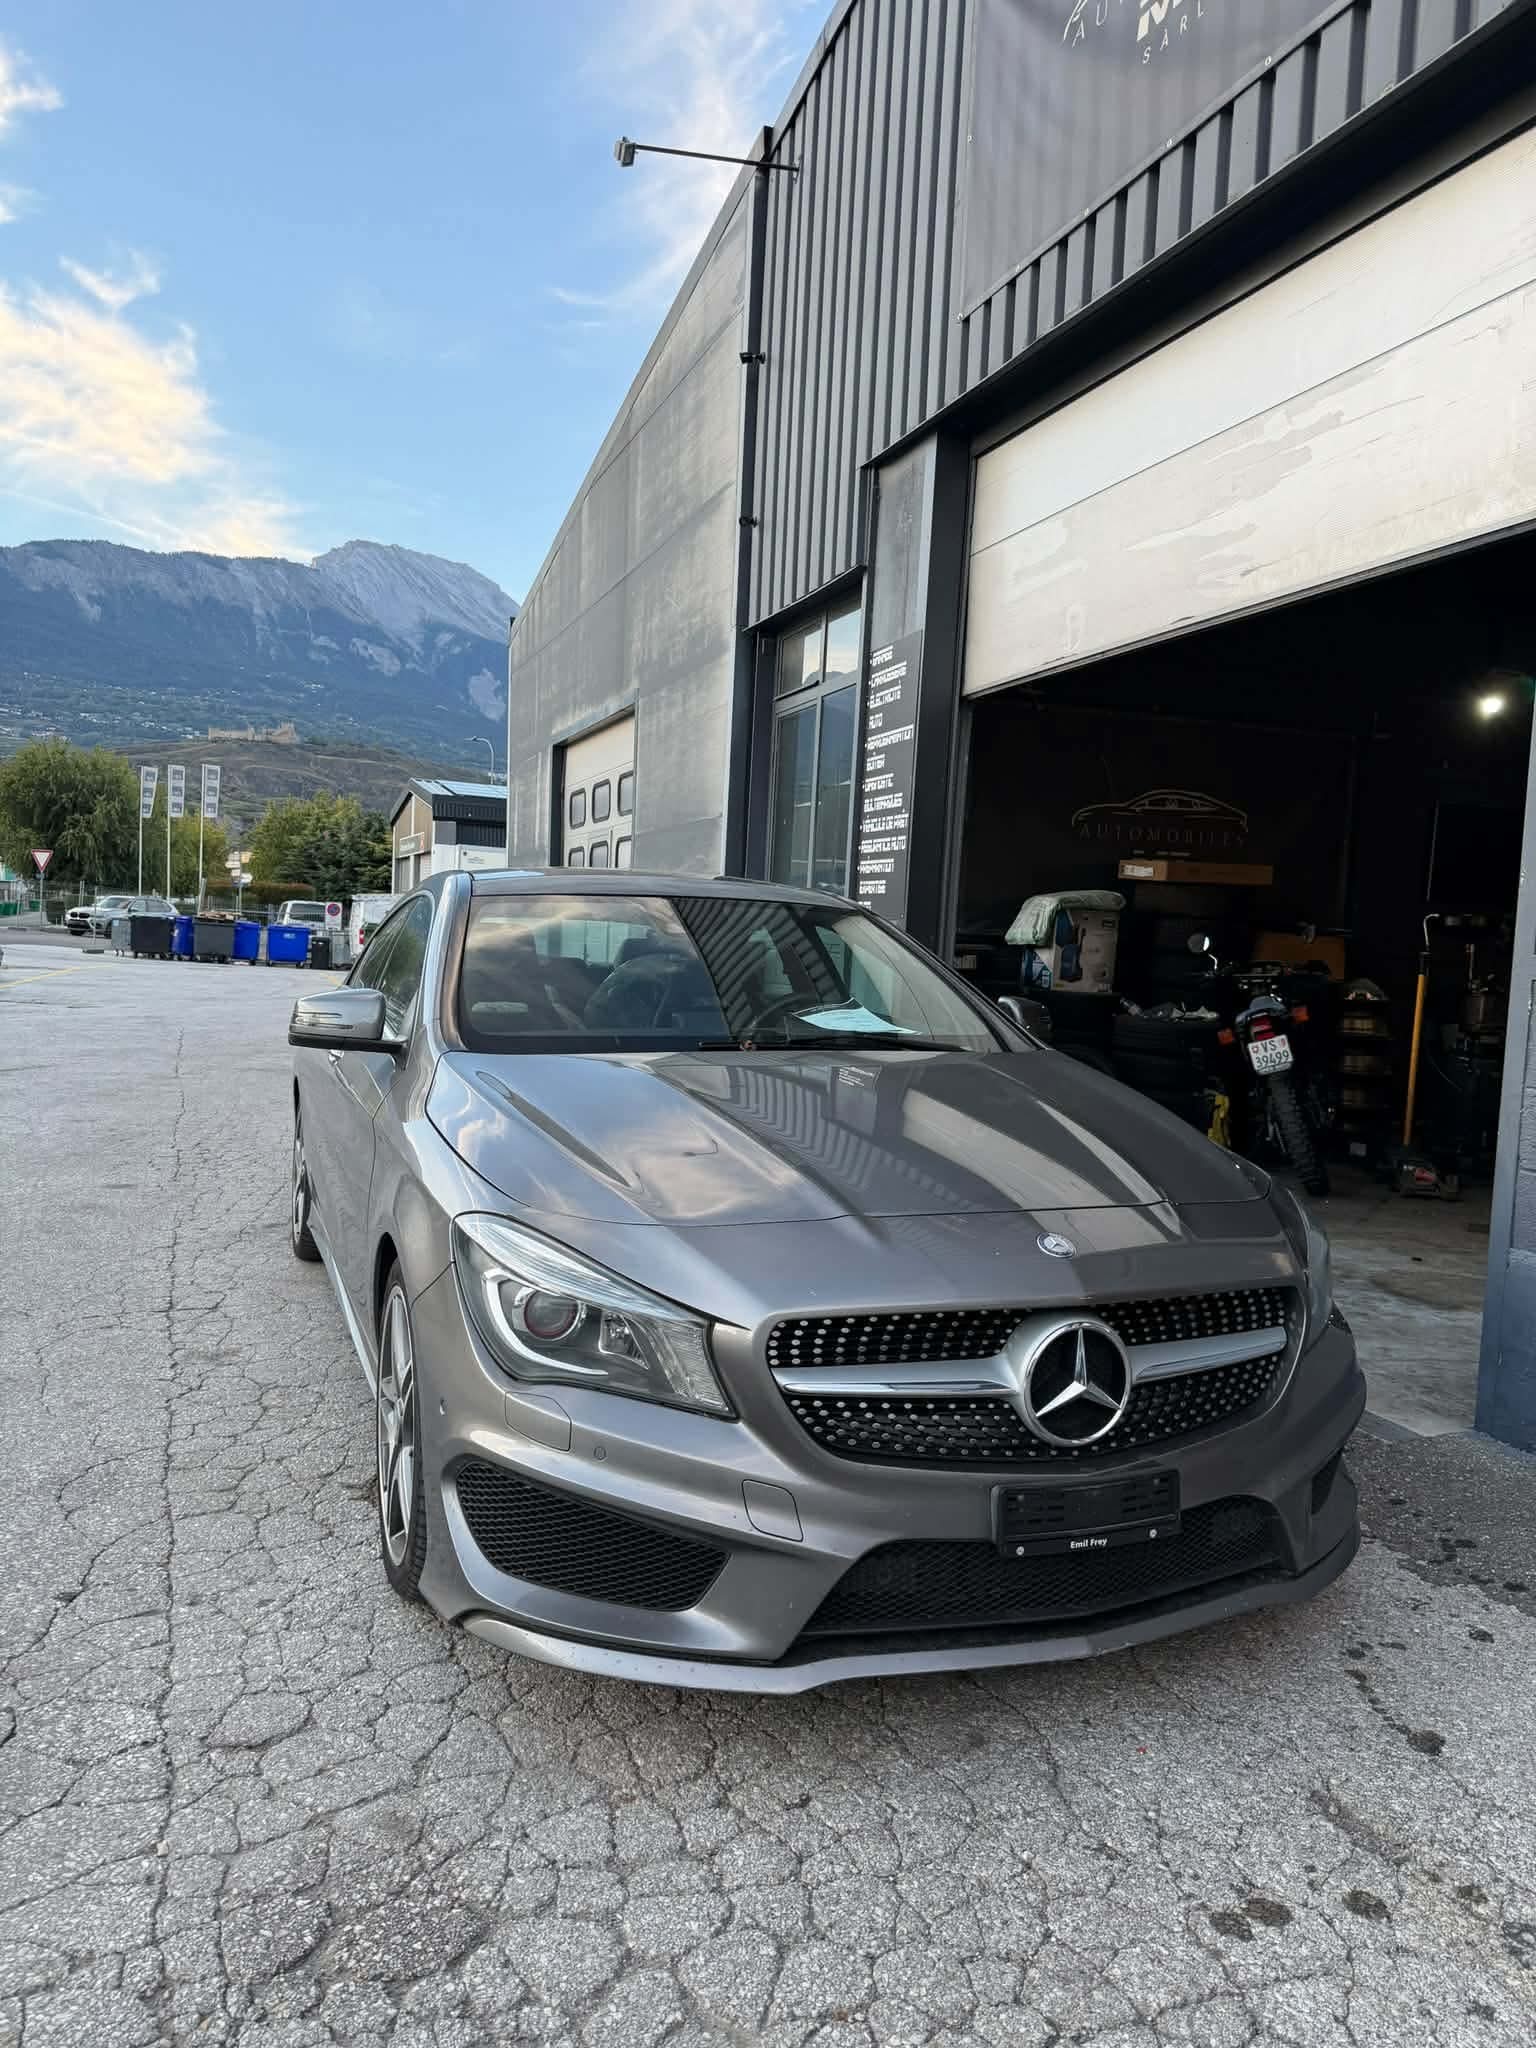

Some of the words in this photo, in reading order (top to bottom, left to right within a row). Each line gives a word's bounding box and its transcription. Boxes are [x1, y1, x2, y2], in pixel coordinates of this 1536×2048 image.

[1260, 1040, 1278, 1053] VS
[1255, 1049, 1290, 1069] 39499
[1070, 1539, 1089, 1549] Emil
[1090, 1538, 1108, 1547] Frey
